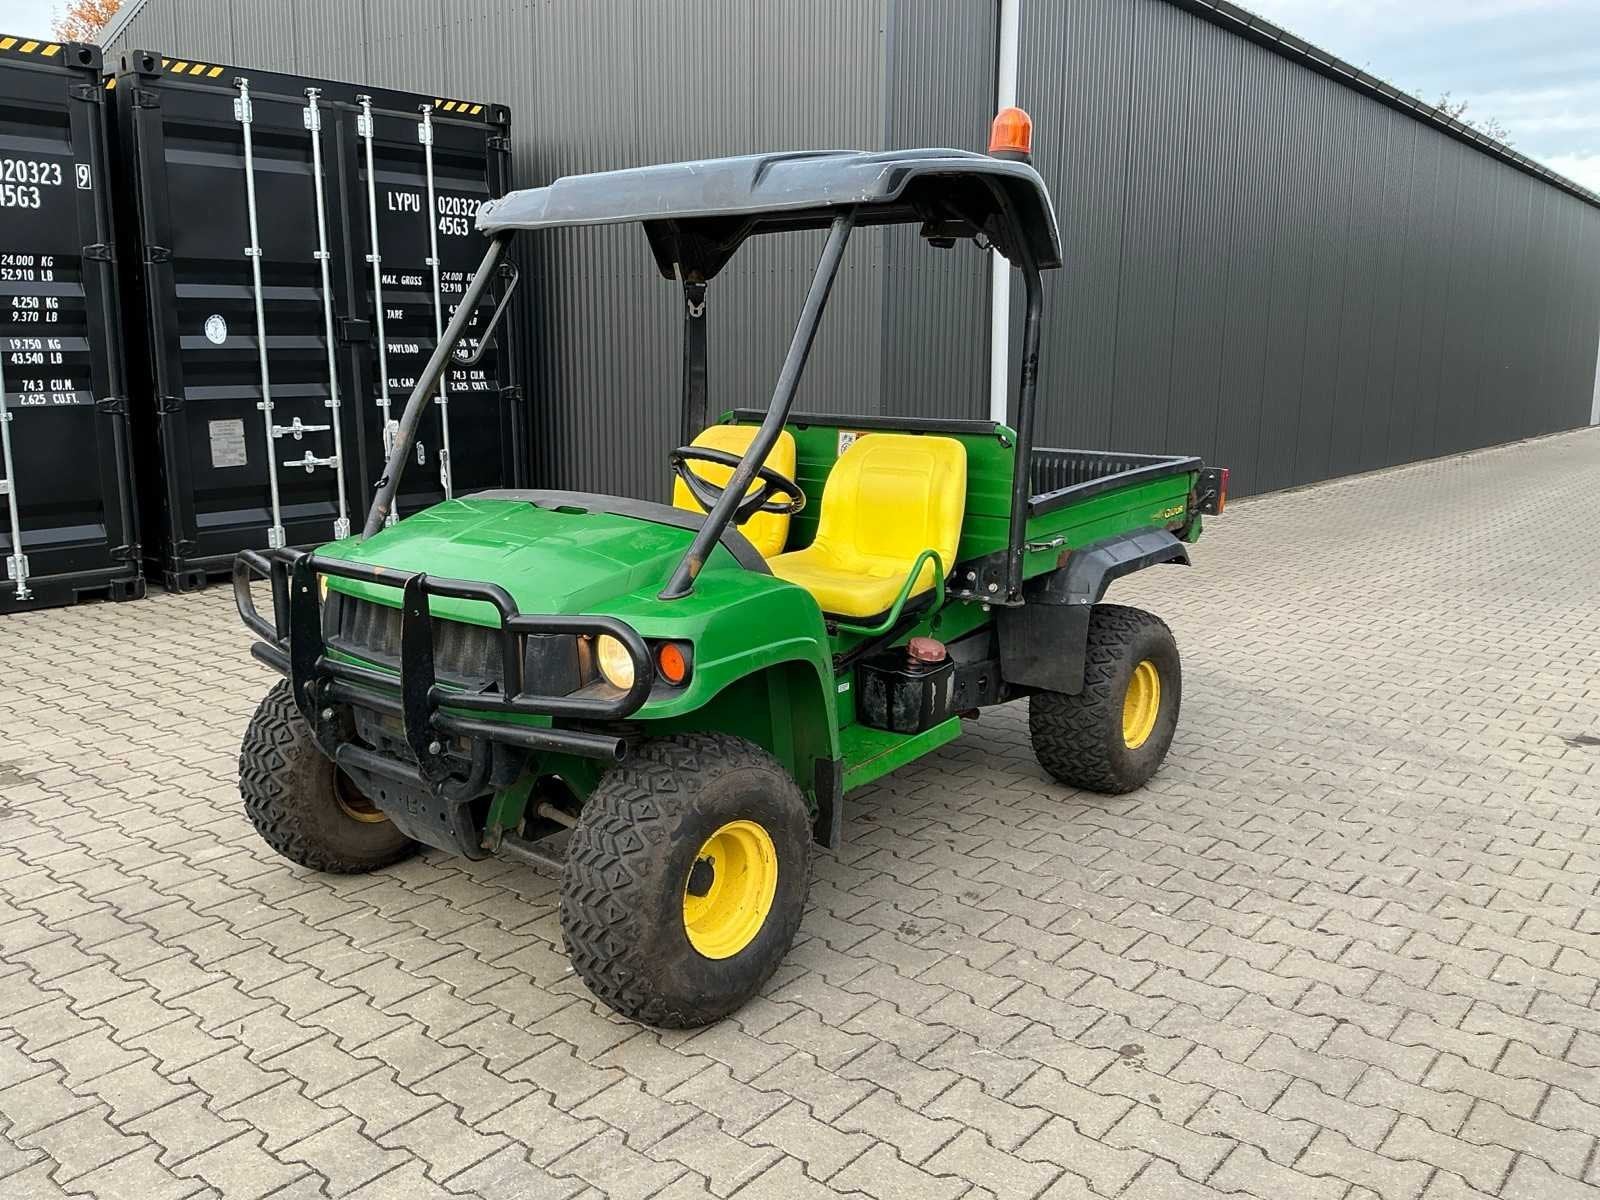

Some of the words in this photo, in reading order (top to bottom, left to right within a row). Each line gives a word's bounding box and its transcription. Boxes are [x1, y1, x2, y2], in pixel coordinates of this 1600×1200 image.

[388, 191, 420, 213] LYPU
[438, 217, 469, 236] 45G3
[0, 254, 34, 266] 24.000
[41, 255, 54, 267] KG
[0, 268, 34, 281] 52.910
[41, 270, 53, 281] LB
[382, 274, 399, 285] MAX.
[401, 275, 423, 286] GROSS
[441, 271, 463, 281] 24.000
[440, 282, 462, 293] 52.910
[12, 296, 39, 309] 4.250
[45, 297, 59, 309] KG
[12, 311, 39, 322] 9.370
[45, 311, 58, 323] LB
[386, 309, 404, 320] TARE
[9, 338, 42, 350] 19.750
[47, 338, 61, 350] KG
[387, 343, 419, 354] PAYLOAD
[11, 352, 44, 365] 43.540
[50, 352, 63, 365] LB
[452, 370, 467, 380] 74.3
[22, 379, 44, 392] 74.3
[50, 378, 75, 391] CU.M.
[19, 393, 47, 406] 2.625
